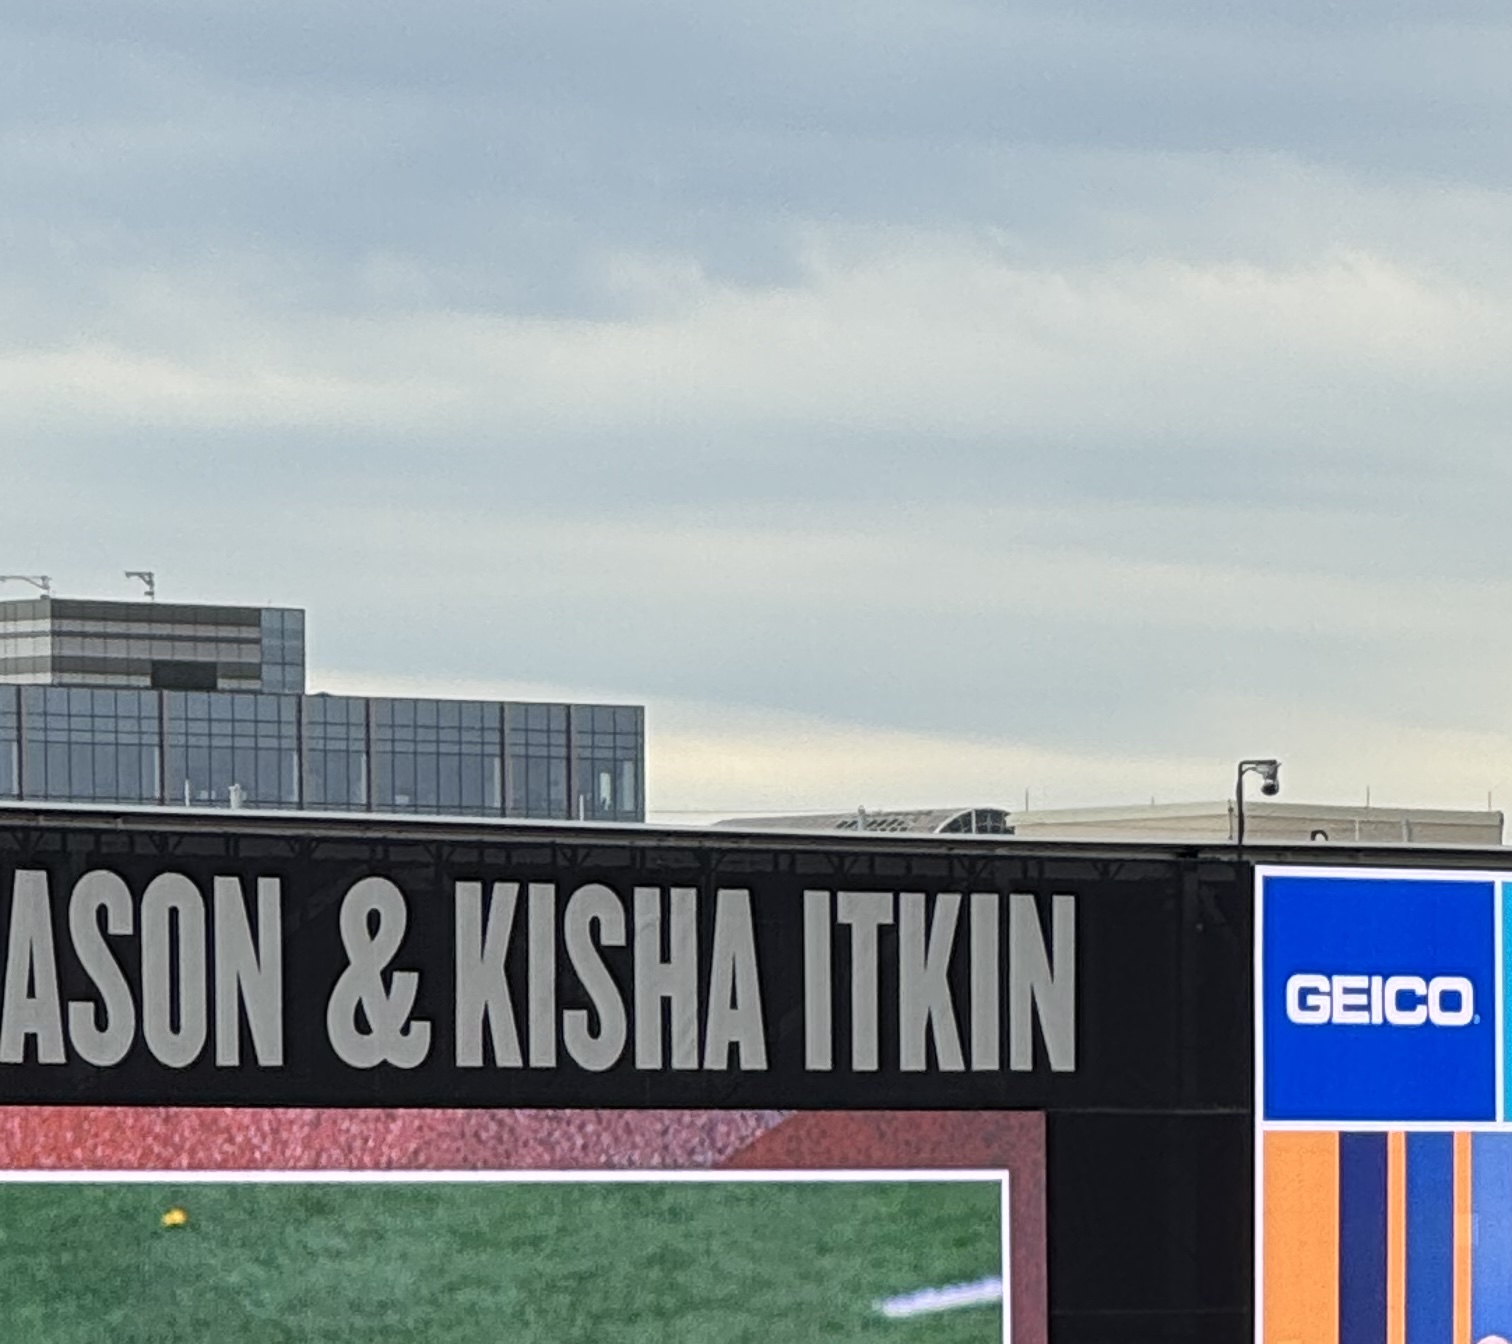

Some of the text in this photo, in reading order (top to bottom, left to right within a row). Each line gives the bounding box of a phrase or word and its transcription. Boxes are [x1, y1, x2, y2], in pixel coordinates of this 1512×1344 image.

[325, 875, 432, 1070] &
[454, 879, 769, 1072] KISHA
[803, 889, 1077, 1073] ITKIN
[1285, 973, 1475, 1026] GEICO
